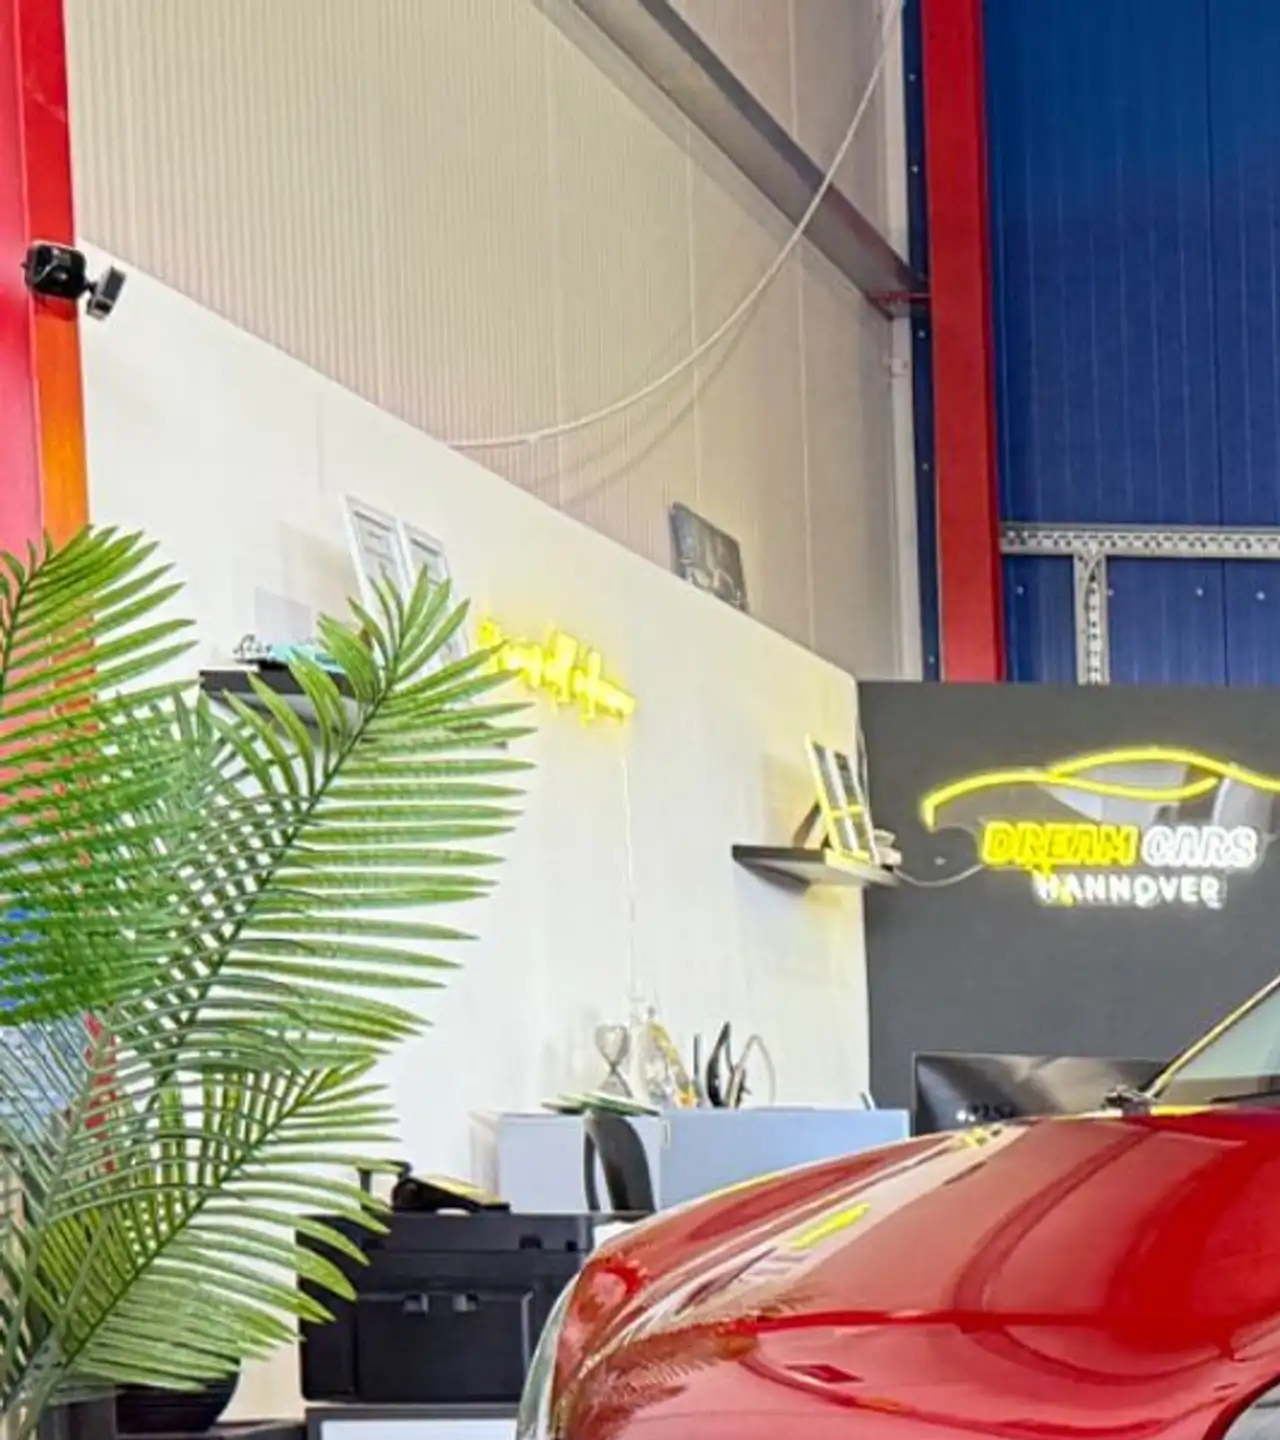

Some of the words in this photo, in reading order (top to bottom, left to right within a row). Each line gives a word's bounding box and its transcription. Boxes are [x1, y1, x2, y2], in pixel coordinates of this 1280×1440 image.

[981, 821, 1140, 867] DREAM
[1141, 824, 1258, 868] CARS
[1032, 872, 1223, 909] HANNOVER
